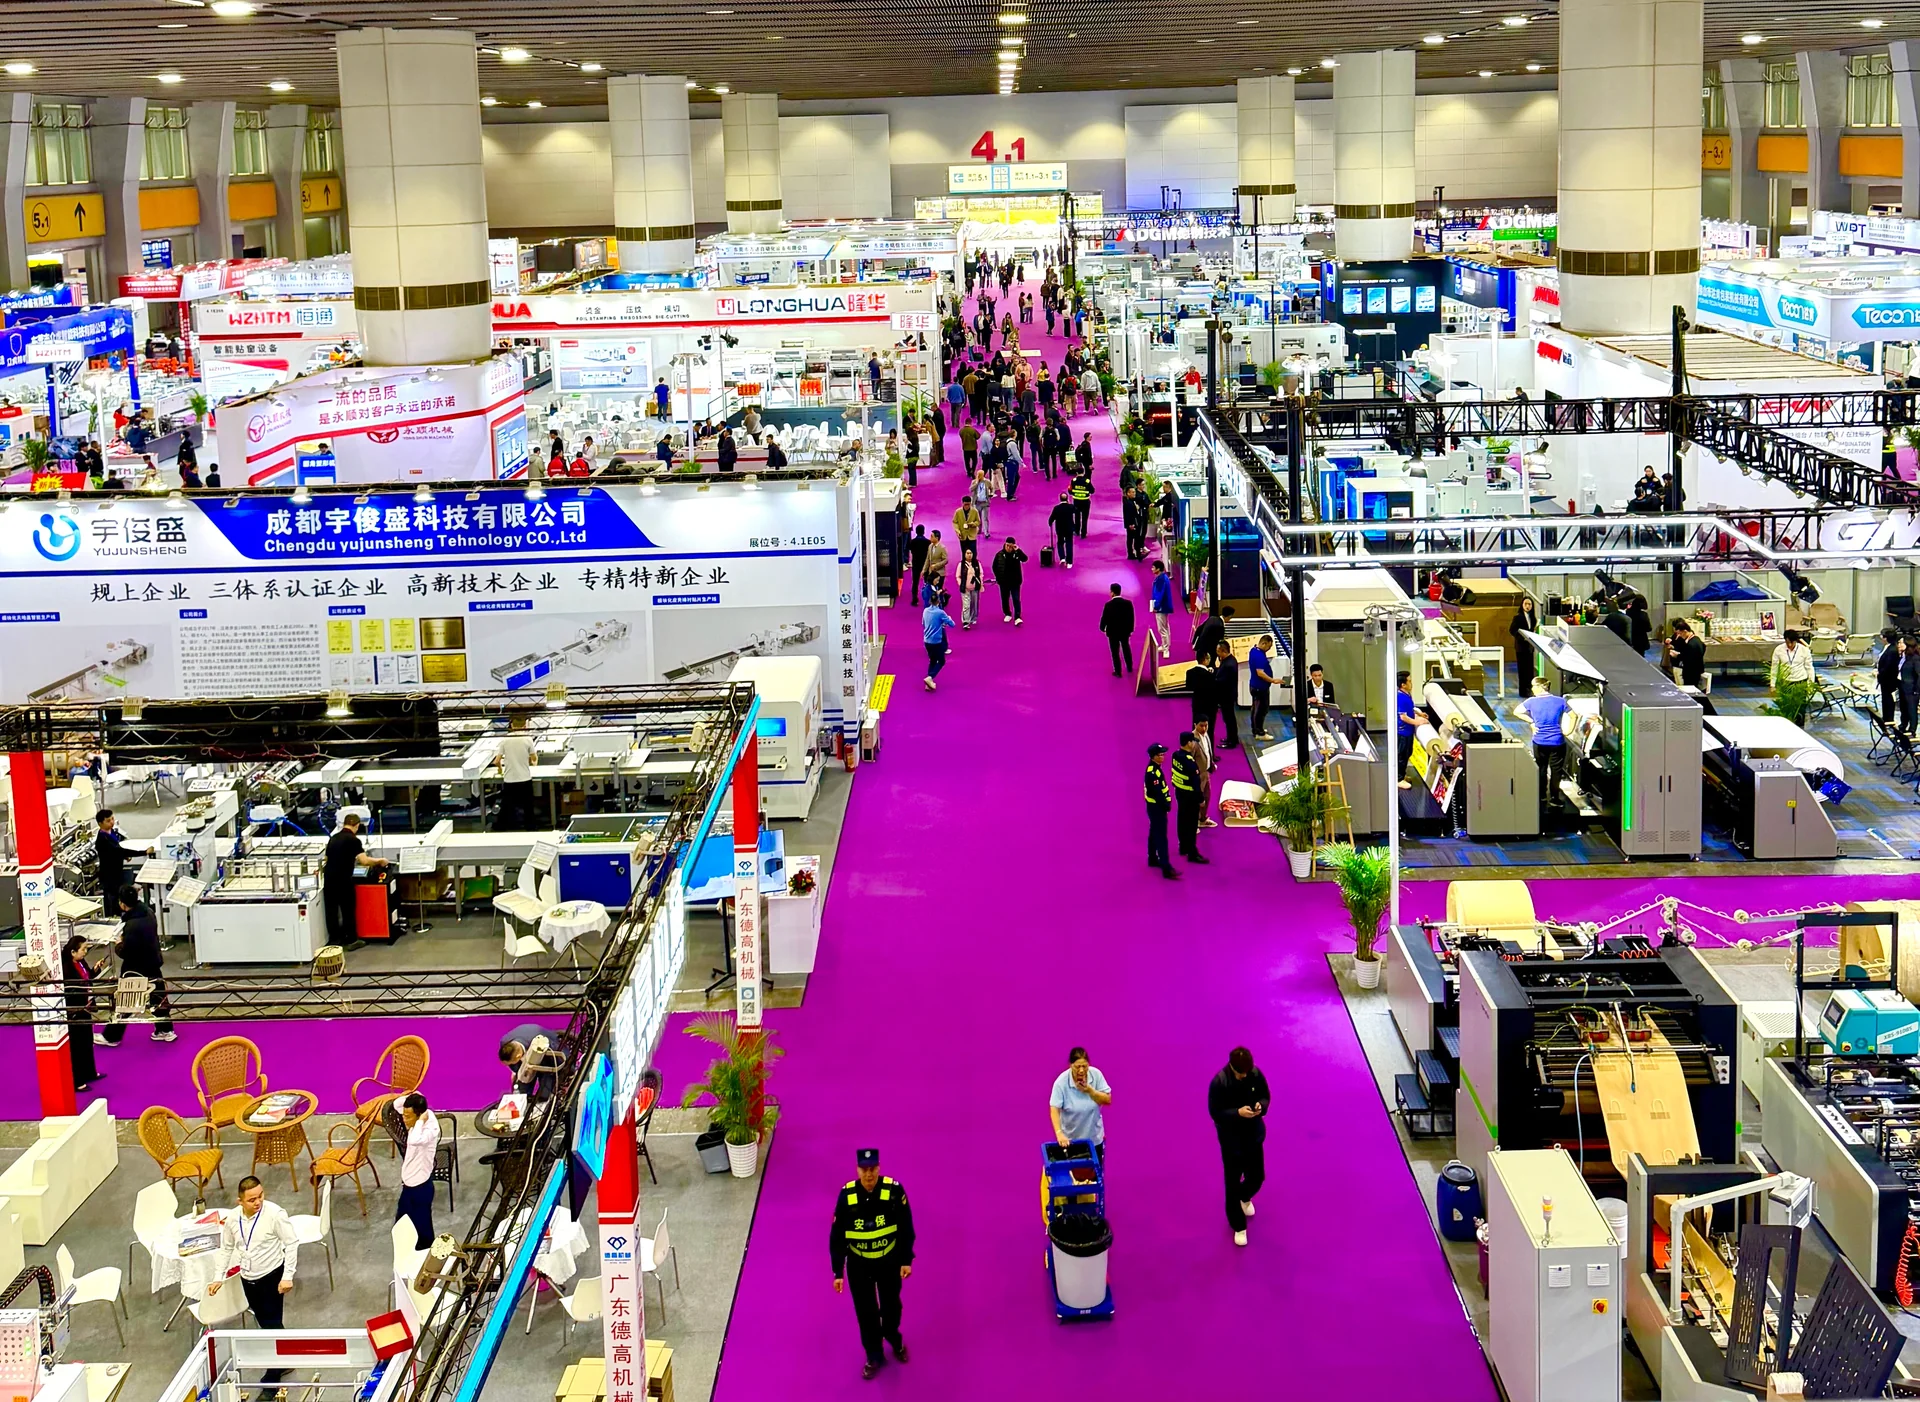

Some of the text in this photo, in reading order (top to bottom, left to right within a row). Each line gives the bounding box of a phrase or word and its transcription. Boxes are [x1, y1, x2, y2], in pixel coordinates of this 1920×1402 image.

[971, 131, 1025, 163] 4.1
[33, 213, 49, 229] 5.1
[1136, 229, 1177, 241] DGM
[626, 306, 642, 314] 压纹
[664, 304, 681, 312] 模切
[737, 293, 887, 313] LONGHUA 隆华
[296, 308, 333, 325] 恒通
[900, 315, 929, 329] 隆华
[214, 344, 278, 354] 智能贴窗设备
[318, 385, 397, 406] 一流的品质
[319, 396, 456, 425] 是永顺对客户永远的承诺
[403, 426, 455, 435] 永顺机械
[266, 500, 586, 536] 成都宇俊盛科技有限公司
[91, 516, 189, 545] 宇俊盛
[93, 546, 187, 557] YUJUNSHENG
[264, 529, 587, 554] Chengdu yujunsheng Tehnology CO.,Ltd
[90, 565, 730, 603] 规上企业 三体系认证企业 高新技术企业 专精特新企业
[841, 609, 853, 678] 宇俊盛科技
[740, 887, 755, 980] 广东德高机械
[857, 1238, 888, 1250] AN BAO
